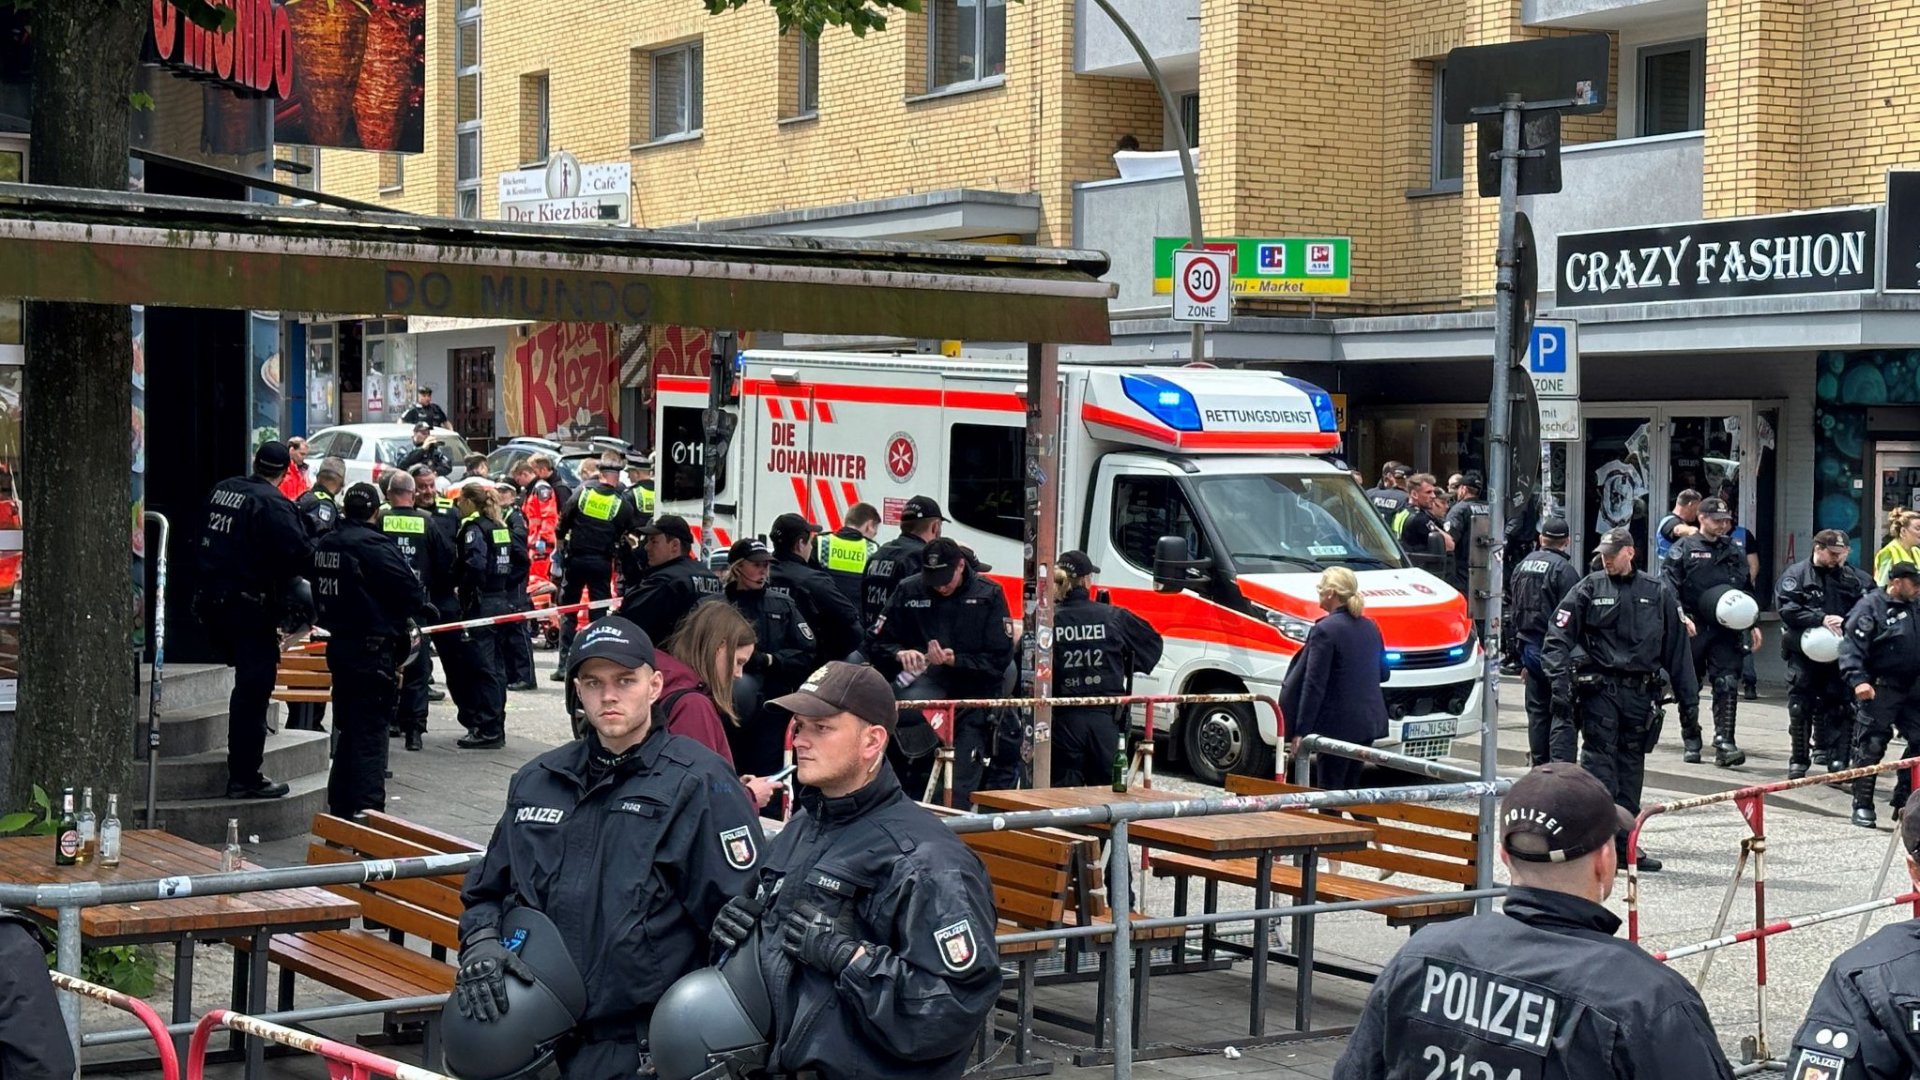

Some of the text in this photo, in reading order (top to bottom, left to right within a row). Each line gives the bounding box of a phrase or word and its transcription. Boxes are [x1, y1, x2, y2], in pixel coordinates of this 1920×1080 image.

[593, 177, 616, 191] Café
[507, 206, 534, 223] Der
[1565, 235, 1691, 293] CRAZY
[1697, 230, 1867, 285] FASHION
[1191, 269, 1213, 290] 30
[1258, 281, 1304, 292] Market
[385, 269, 650, 320] DO MUNDO
[1187, 305, 1216, 318] ZONE
[1538, 332, 1558, 367] P
[1205, 409, 1312, 424] RETTUNGSDIENST
[771, 422, 796, 447] DIE
[767, 449, 867, 480] JOHANNITER
[210, 489, 246, 510] POLIZEI
[1373, 498, 1398, 509] POLIZEI
[315, 551, 341, 568] POLIZEI
[831, 548, 864, 562] POLIZEI
[867, 560, 893, 577] POLIZEI
[1520, 561, 1550, 573] POLIZEI
[1055, 624, 1106, 642] POLIZEI
[1063, 649, 1103, 669] 2212
[515, 807, 564, 824] POLIZEI
[1504, 807, 1563, 835] POLIZEI
[723, 829, 748, 841] POLIZEI
[818, 876, 840, 890] 21243
[938, 924, 968, 941] POLIZEI
[1420, 965, 1556, 1048] POLIZEI
[1803, 1053, 1841, 1069] POLIZEI
